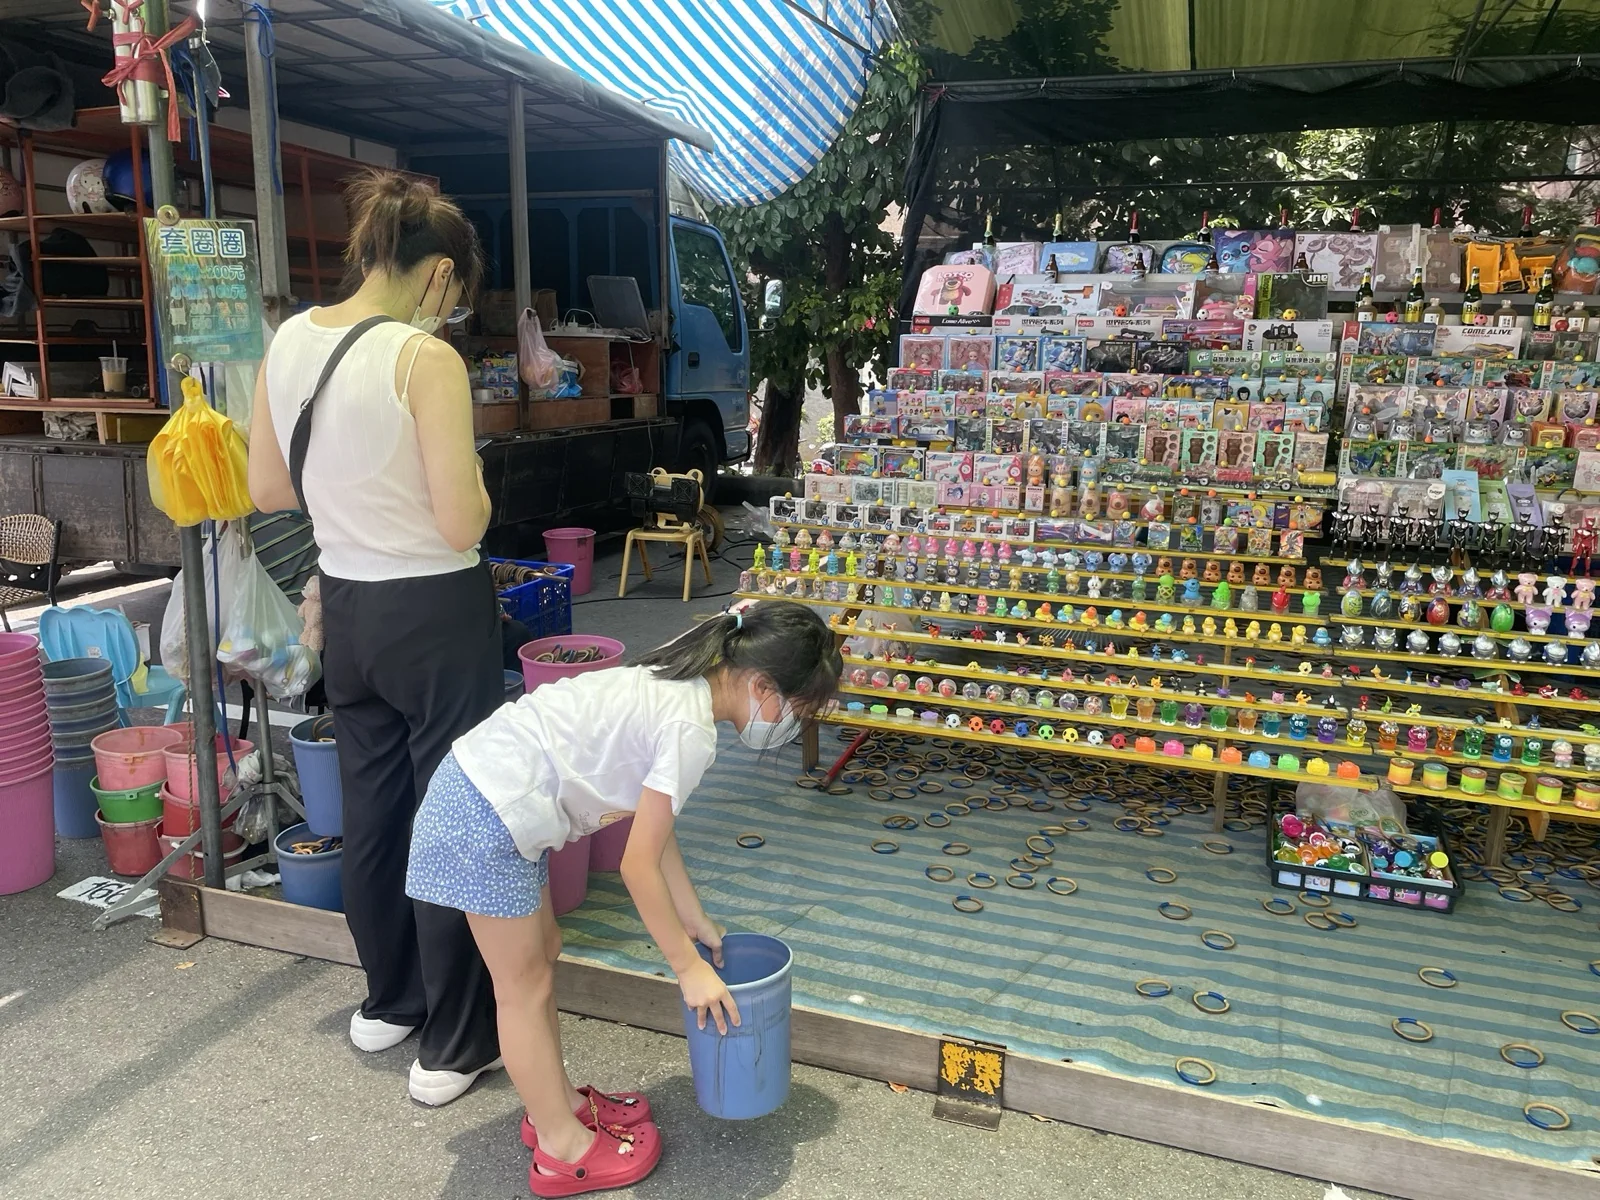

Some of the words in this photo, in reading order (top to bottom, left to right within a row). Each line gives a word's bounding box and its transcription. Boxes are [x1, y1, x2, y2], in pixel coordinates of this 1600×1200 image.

[160, 227, 246, 257] 套圈圈
[1406, 303, 1423, 312] Bar
[1462, 327, 1487, 335] COME
[1486, 328, 1514, 336] ALIVE
